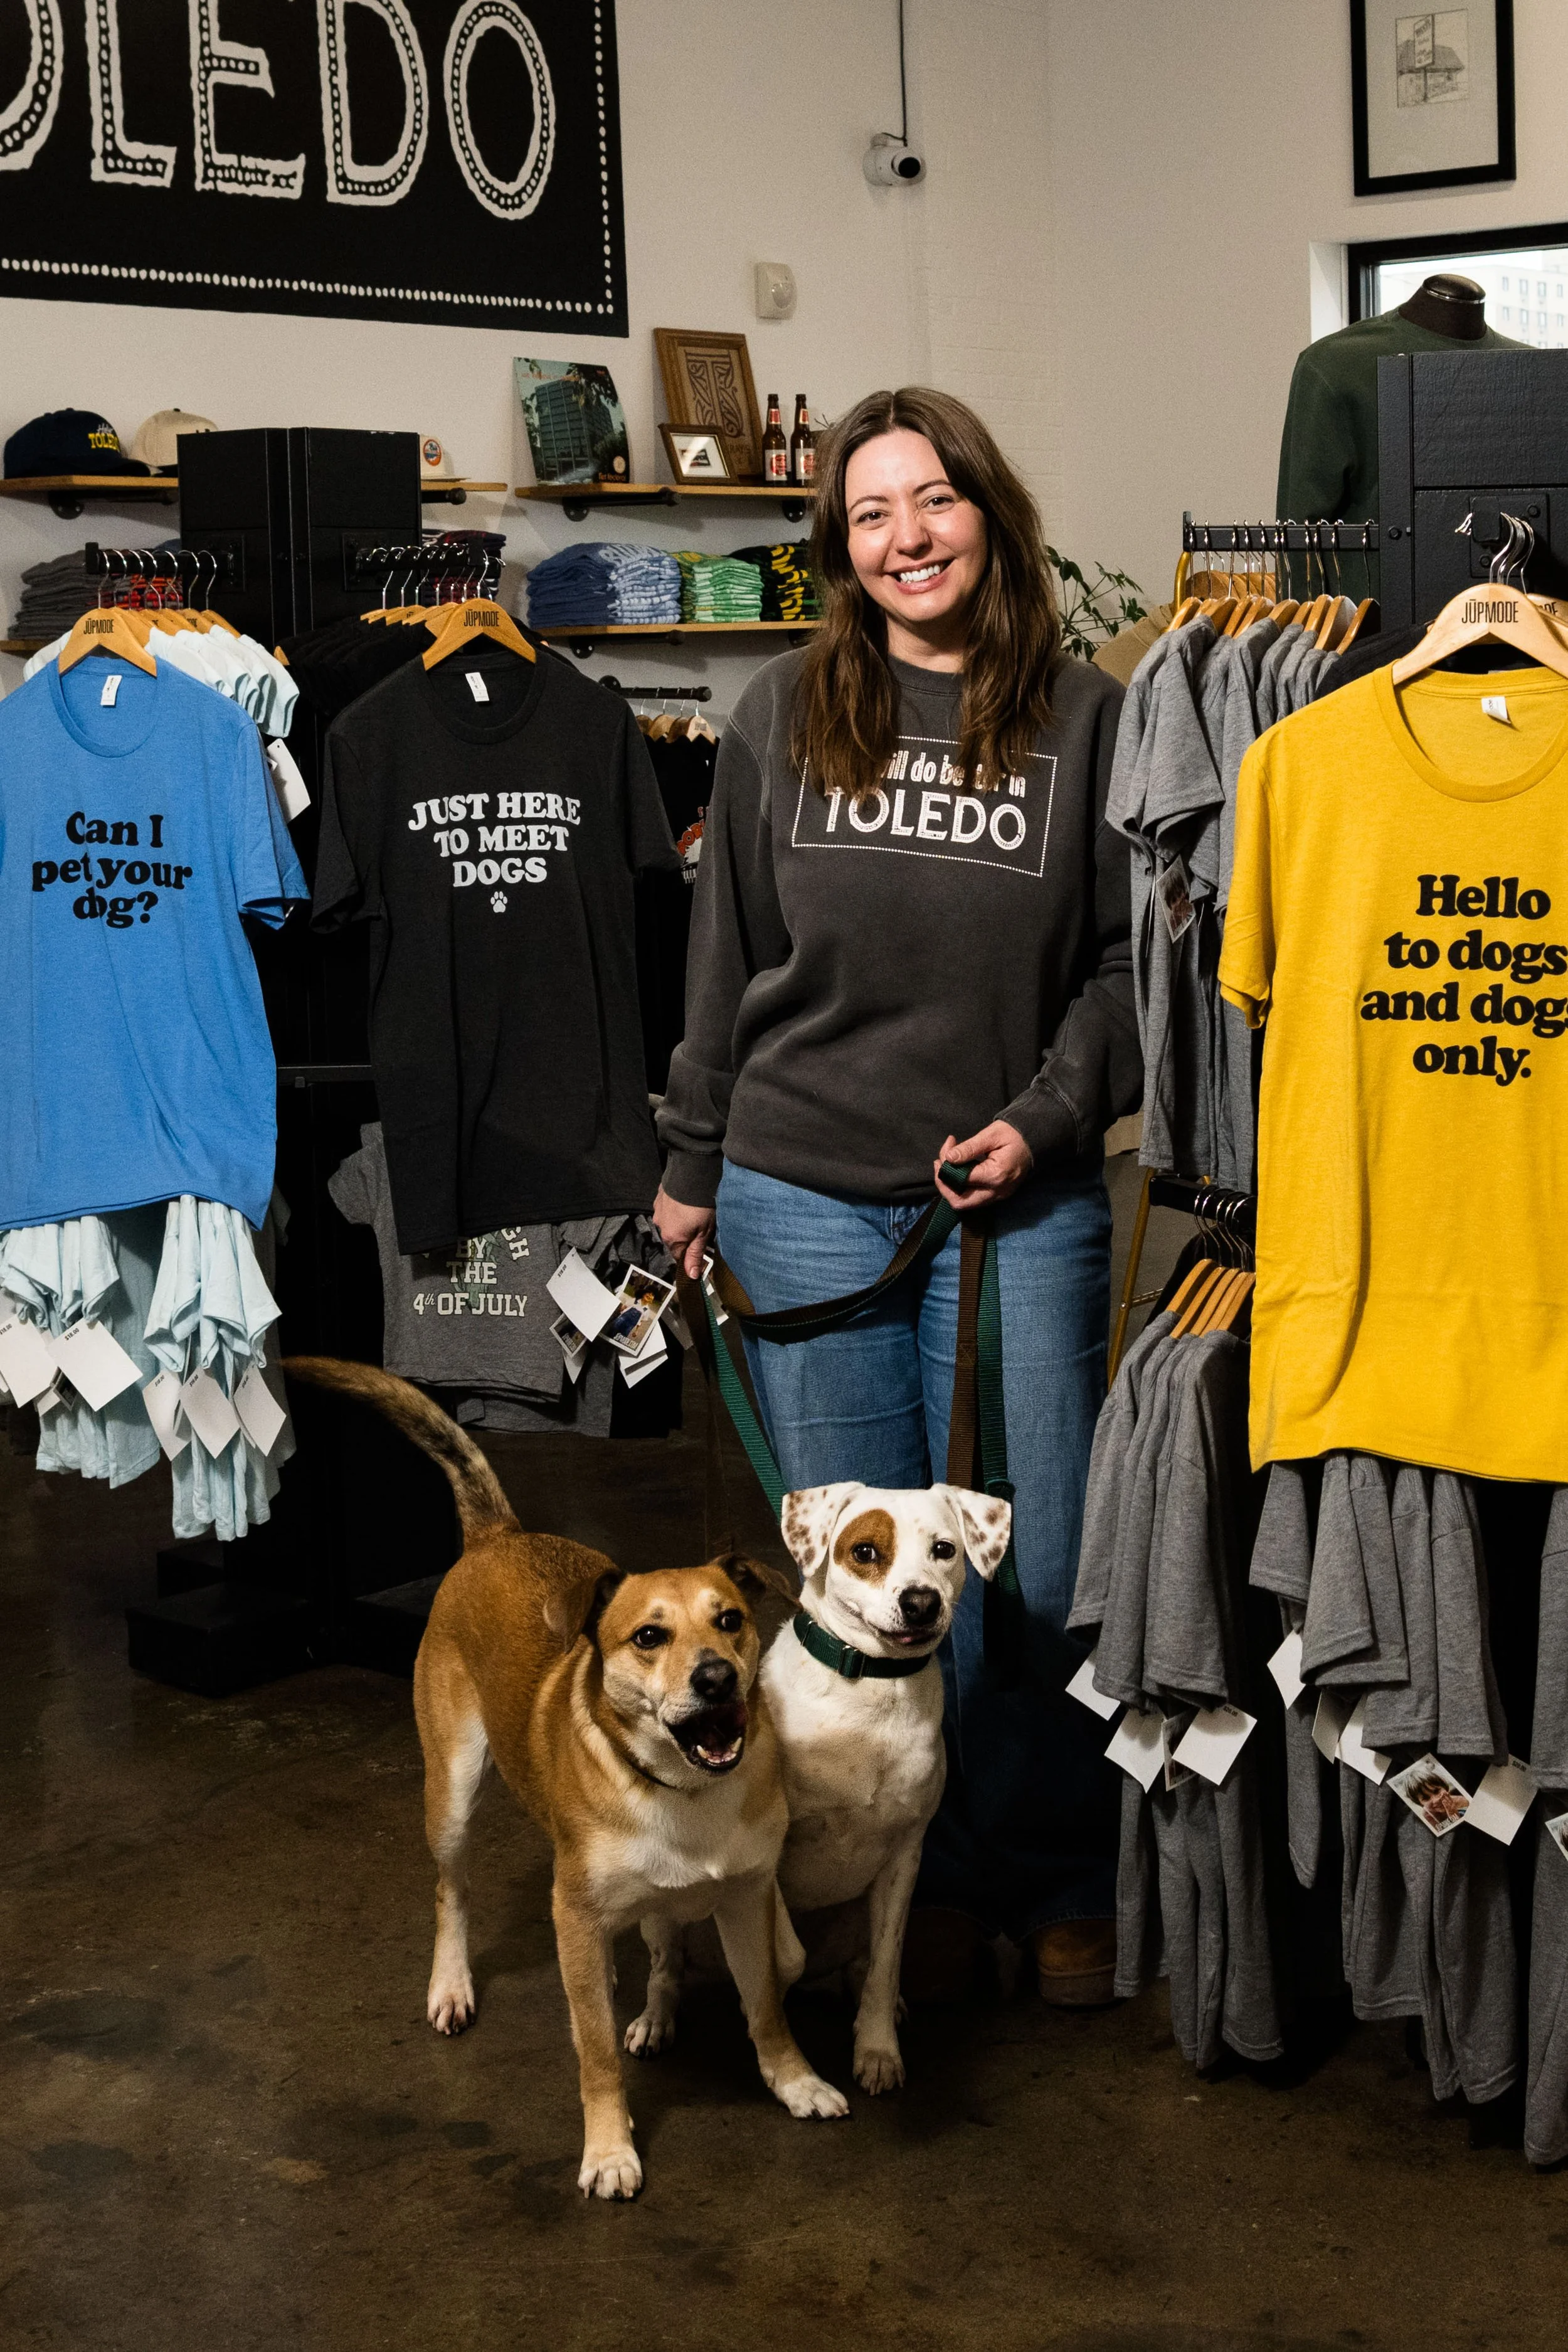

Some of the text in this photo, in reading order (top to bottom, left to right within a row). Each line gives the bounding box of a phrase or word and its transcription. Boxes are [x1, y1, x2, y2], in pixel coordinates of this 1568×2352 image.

[881, 750, 909, 780] ill
[911, 752, 936, 783] do
[1009, 768, 1026, 798] in
[66, 811, 164, 848] Can I
[408, 792, 581, 830] JUST HERE
[824, 786, 1026, 850] TOLEDO
[433, 825, 569, 857] TO MEET
[32, 852, 193, 892] pet your
[453, 857, 547, 887] DOGS
[73, 886, 159, 929] dog?
[1416, 874, 1551, 920] Hello
[1384, 929, 1568, 985] to dogs
[1360, 982, 1568, 1039] and dog
[1413, 1036, 1532, 1086] only.
[456, 1236, 487, 1259] BY
[446, 1262, 497, 1284] THE
[413, 1293, 527, 1317] 4th OF JULY
